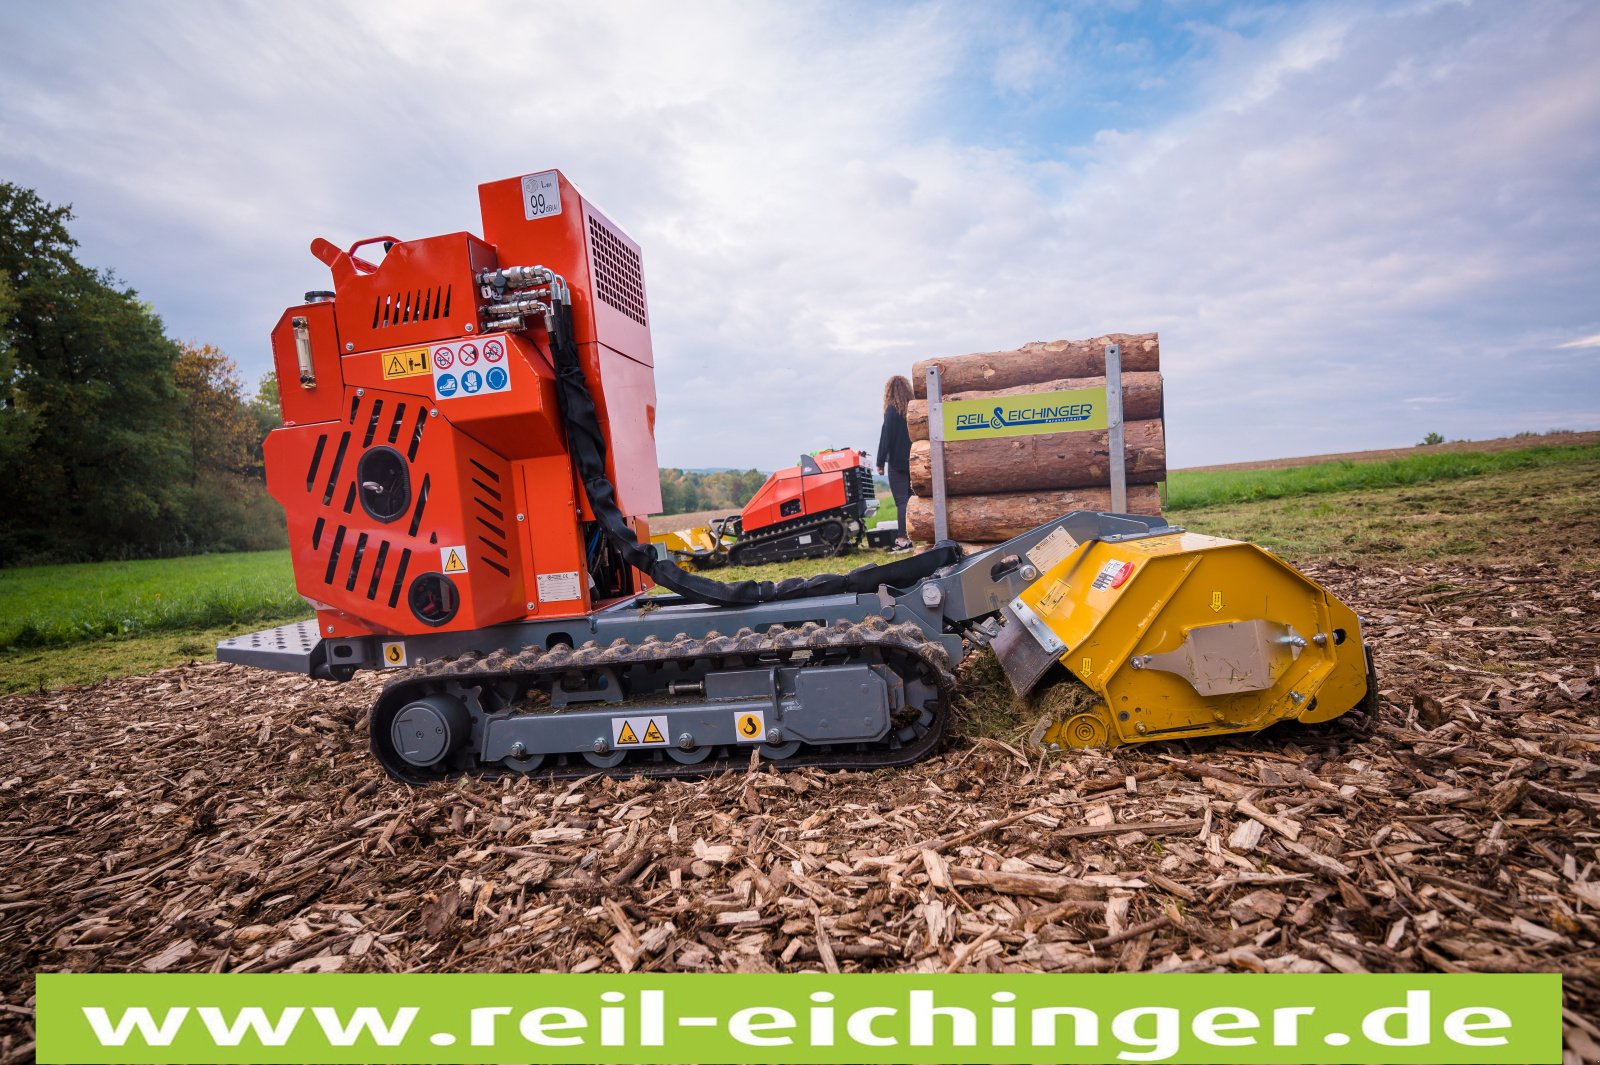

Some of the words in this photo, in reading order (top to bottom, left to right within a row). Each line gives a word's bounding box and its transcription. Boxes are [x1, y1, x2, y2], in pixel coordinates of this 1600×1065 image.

[530, 193, 546, 216] 99
[956, 413, 990, 425] REIL
[1008, 403, 1093, 421] EICHINGER
